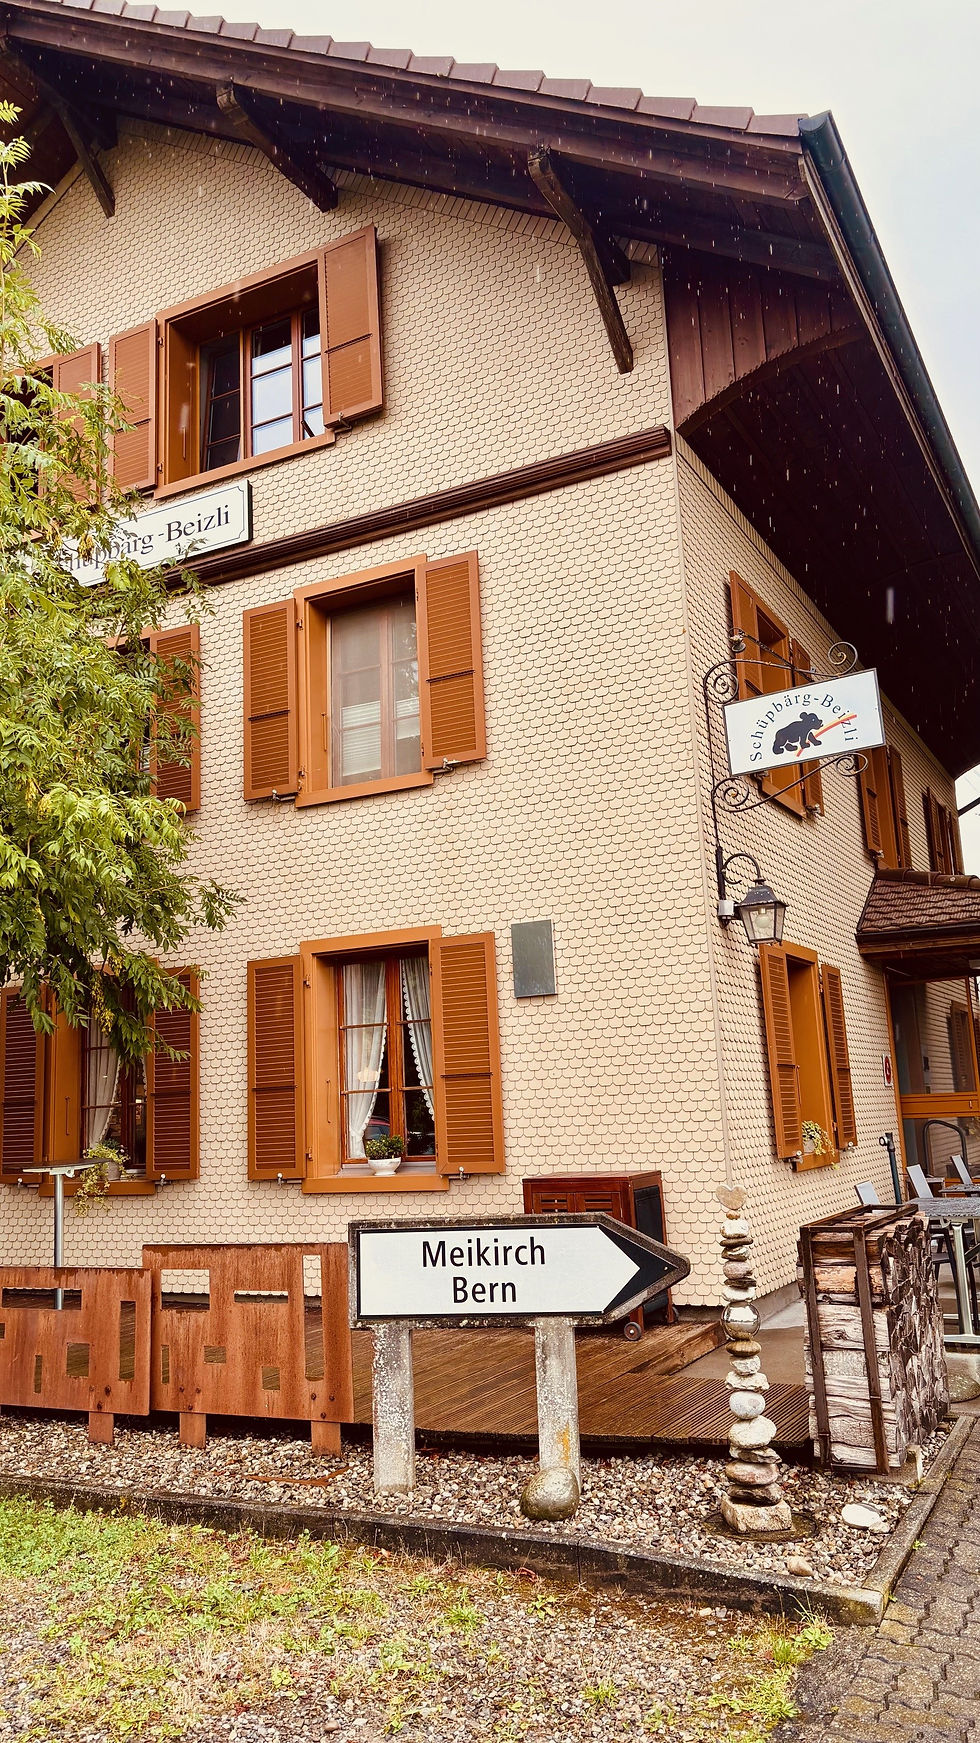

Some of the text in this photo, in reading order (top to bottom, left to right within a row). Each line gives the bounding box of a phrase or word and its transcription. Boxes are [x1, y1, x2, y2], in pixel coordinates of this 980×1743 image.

[57, 504, 231, 571] hpbärg-Beizli
[421, 1236, 546, 1268] Meikirch
[452, 1276, 517, 1304] Bern
